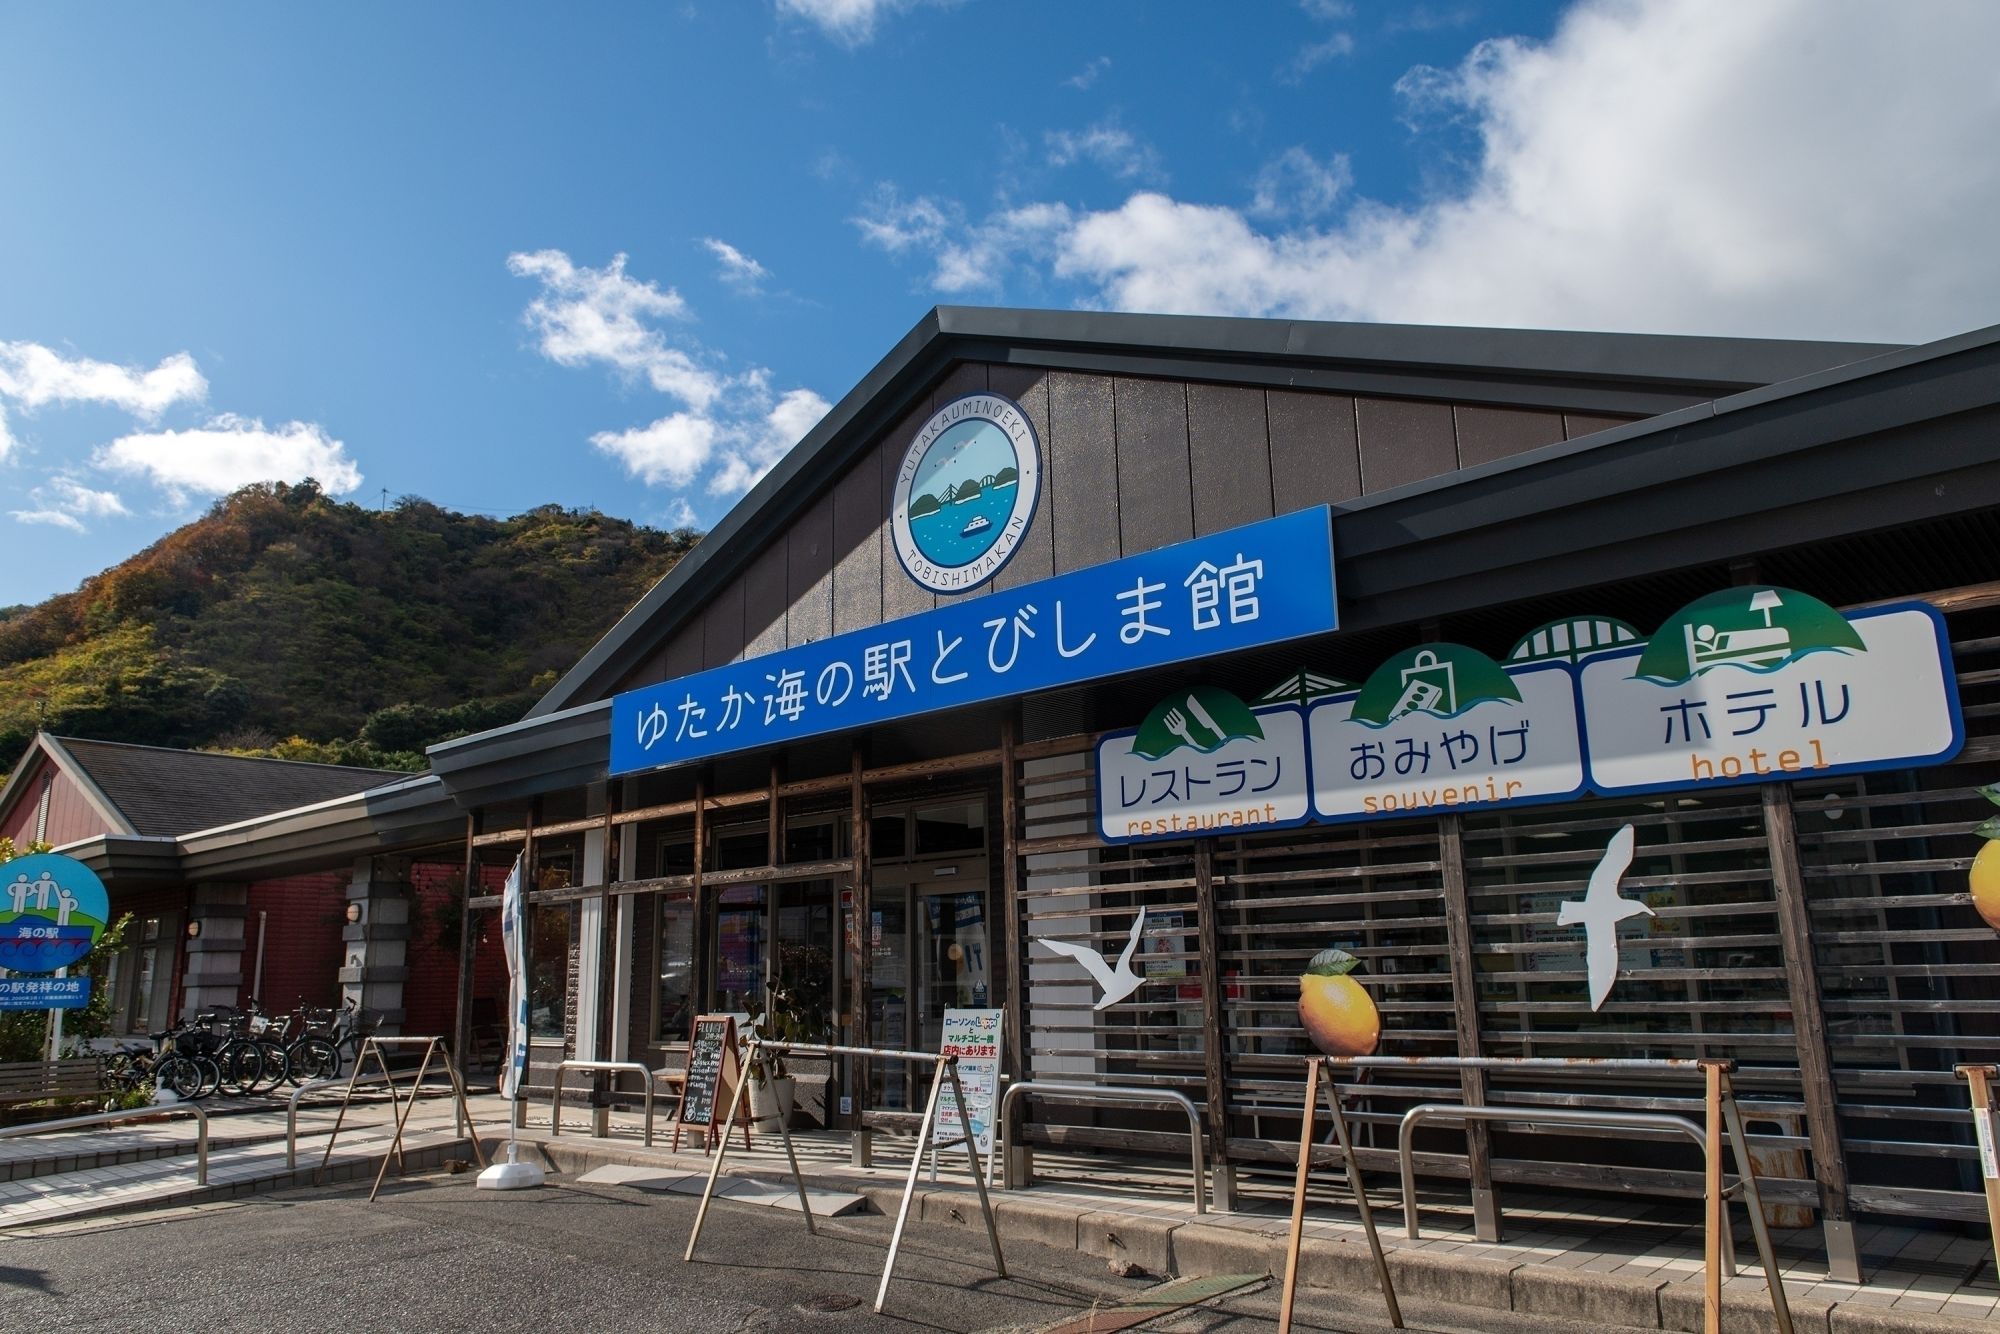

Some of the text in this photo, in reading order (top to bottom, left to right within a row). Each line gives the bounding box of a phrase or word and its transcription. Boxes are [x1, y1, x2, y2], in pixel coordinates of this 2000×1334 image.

[900, 400, 1026, 484] YUTAKAUMINOEKI
[907, 516, 1024, 586] TOBISHIMAKAN
[636, 552, 1264, 752] ゆたか海の駅とびしま館
[1659, 679, 1851, 744] ホテル
[1349, 718, 1531, 781] おみやげ
[1691, 738, 1832, 782] hotel
[1119, 755, 1282, 808] レストラン
[1362, 775, 1524, 815] souvenir
[1127, 802, 1278, 838] restaurant
[18, 927, 59, 939] 海の駅
[948, 1035, 994, 1043] マルチコピー機
